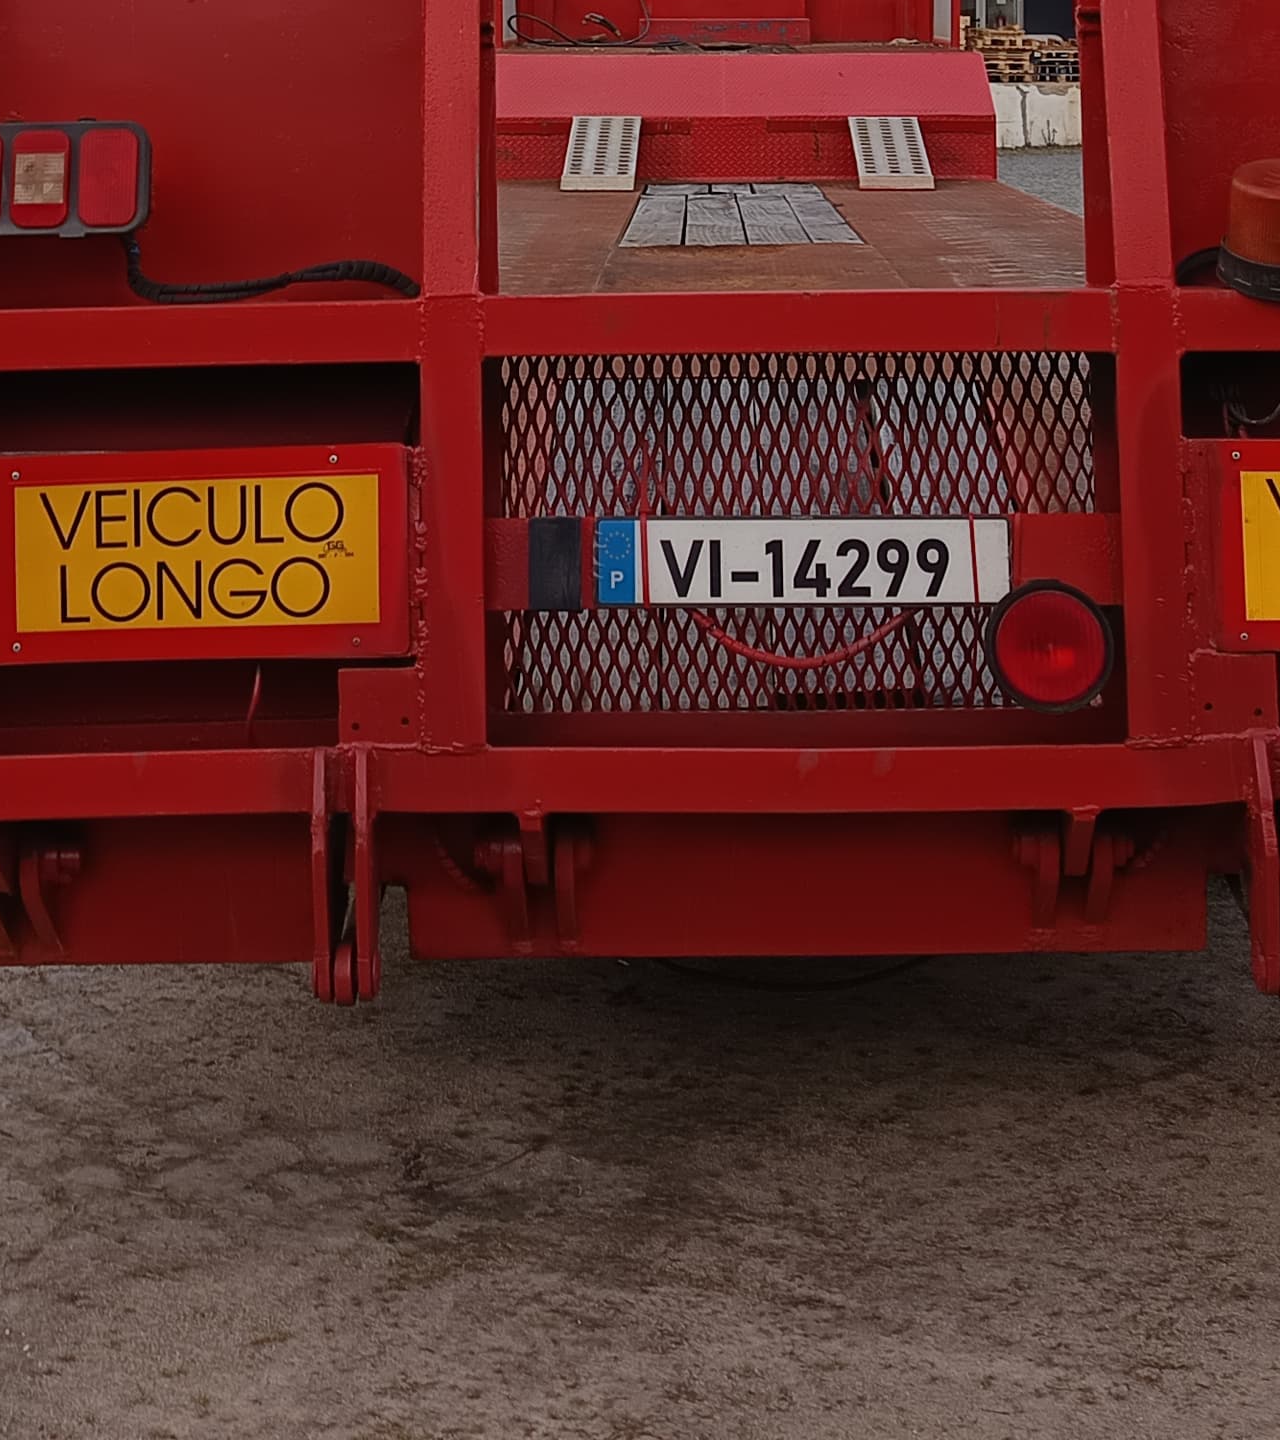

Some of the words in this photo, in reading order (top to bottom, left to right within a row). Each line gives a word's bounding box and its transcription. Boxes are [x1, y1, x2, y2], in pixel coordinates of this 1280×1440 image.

[39, 482, 344, 550] VEICULO
[60, 556, 330, 623] LONGO
[610, 570, 624, 589] P
[660, 538, 950, 598] VI-14299
